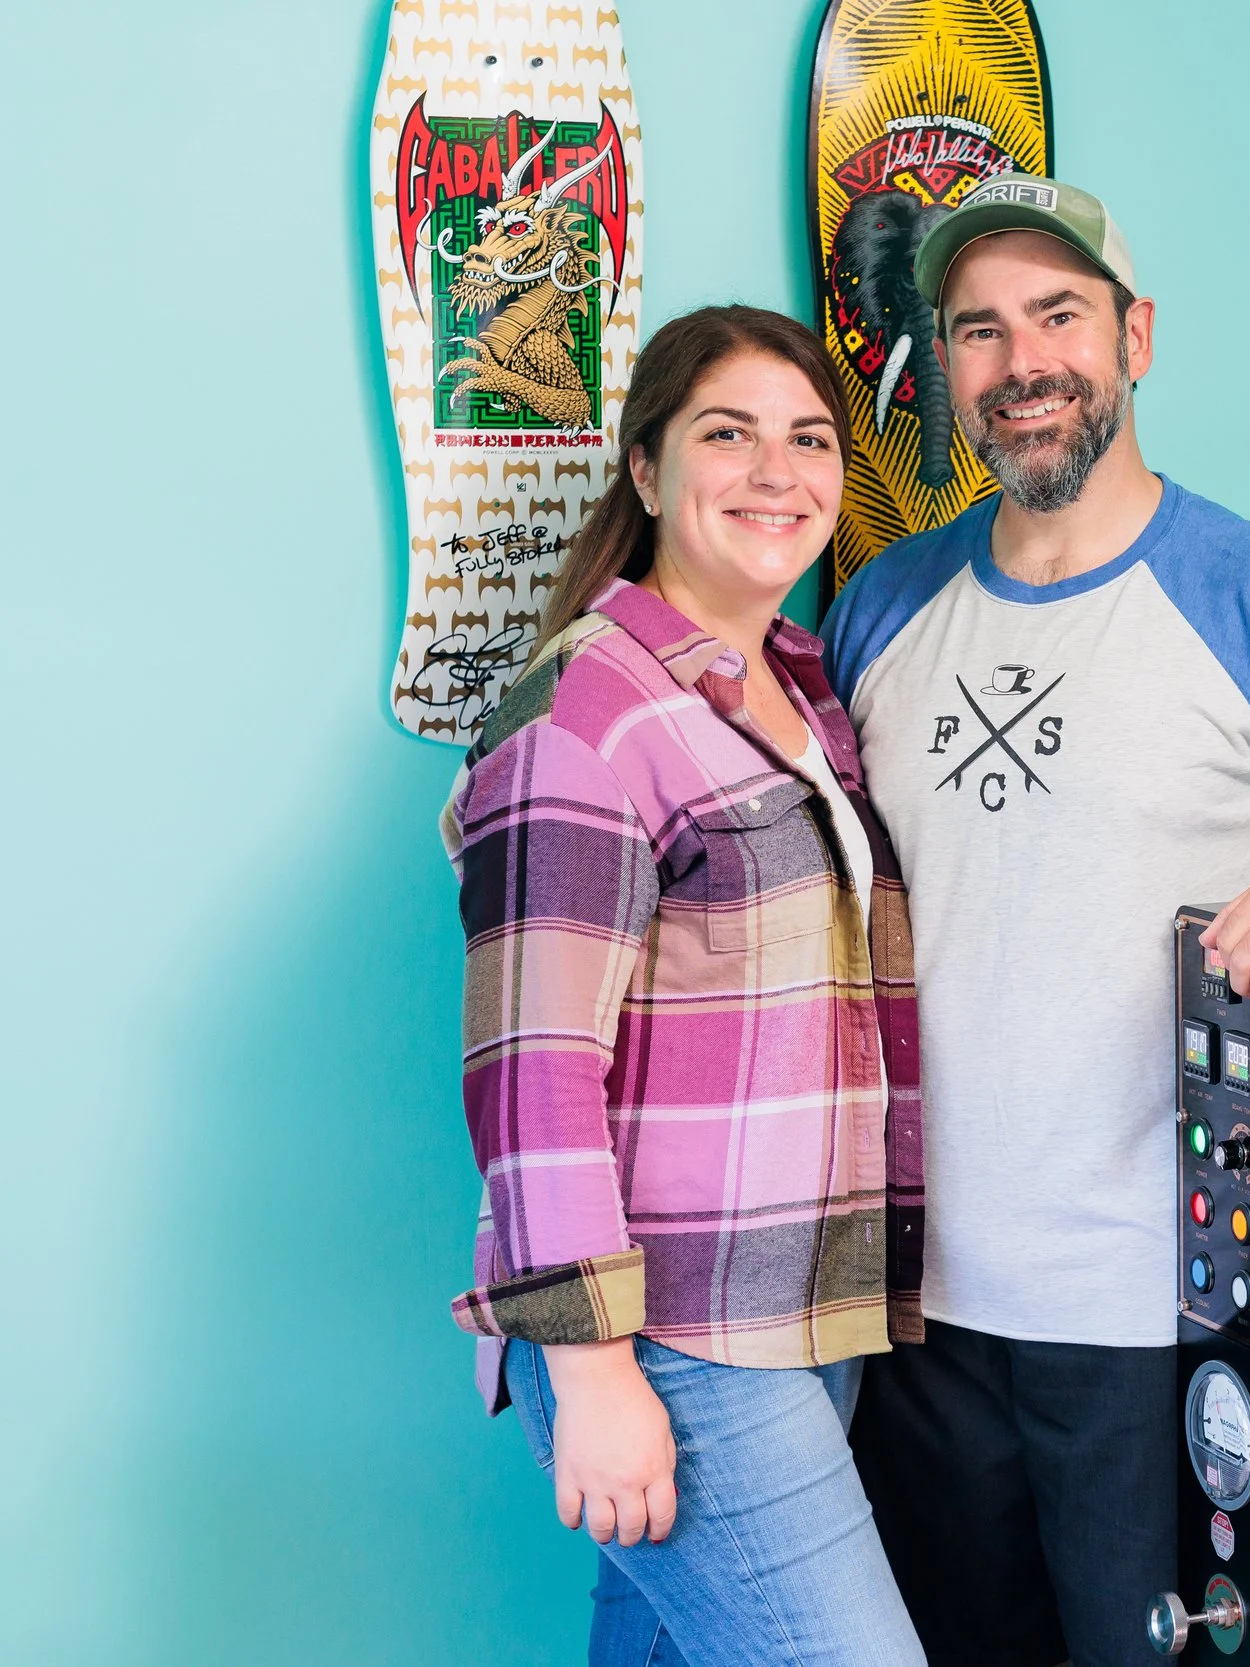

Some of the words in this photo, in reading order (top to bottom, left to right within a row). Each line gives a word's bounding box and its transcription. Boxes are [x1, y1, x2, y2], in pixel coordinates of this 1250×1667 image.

[886, 115, 935, 133] POWELL
[943, 115, 993, 139] PERALTA
[397, 90, 627, 324] CABALLERO
[927, 716, 960, 754] F
[1035, 716, 1063, 756] S
[980, 772, 1006, 812] C
